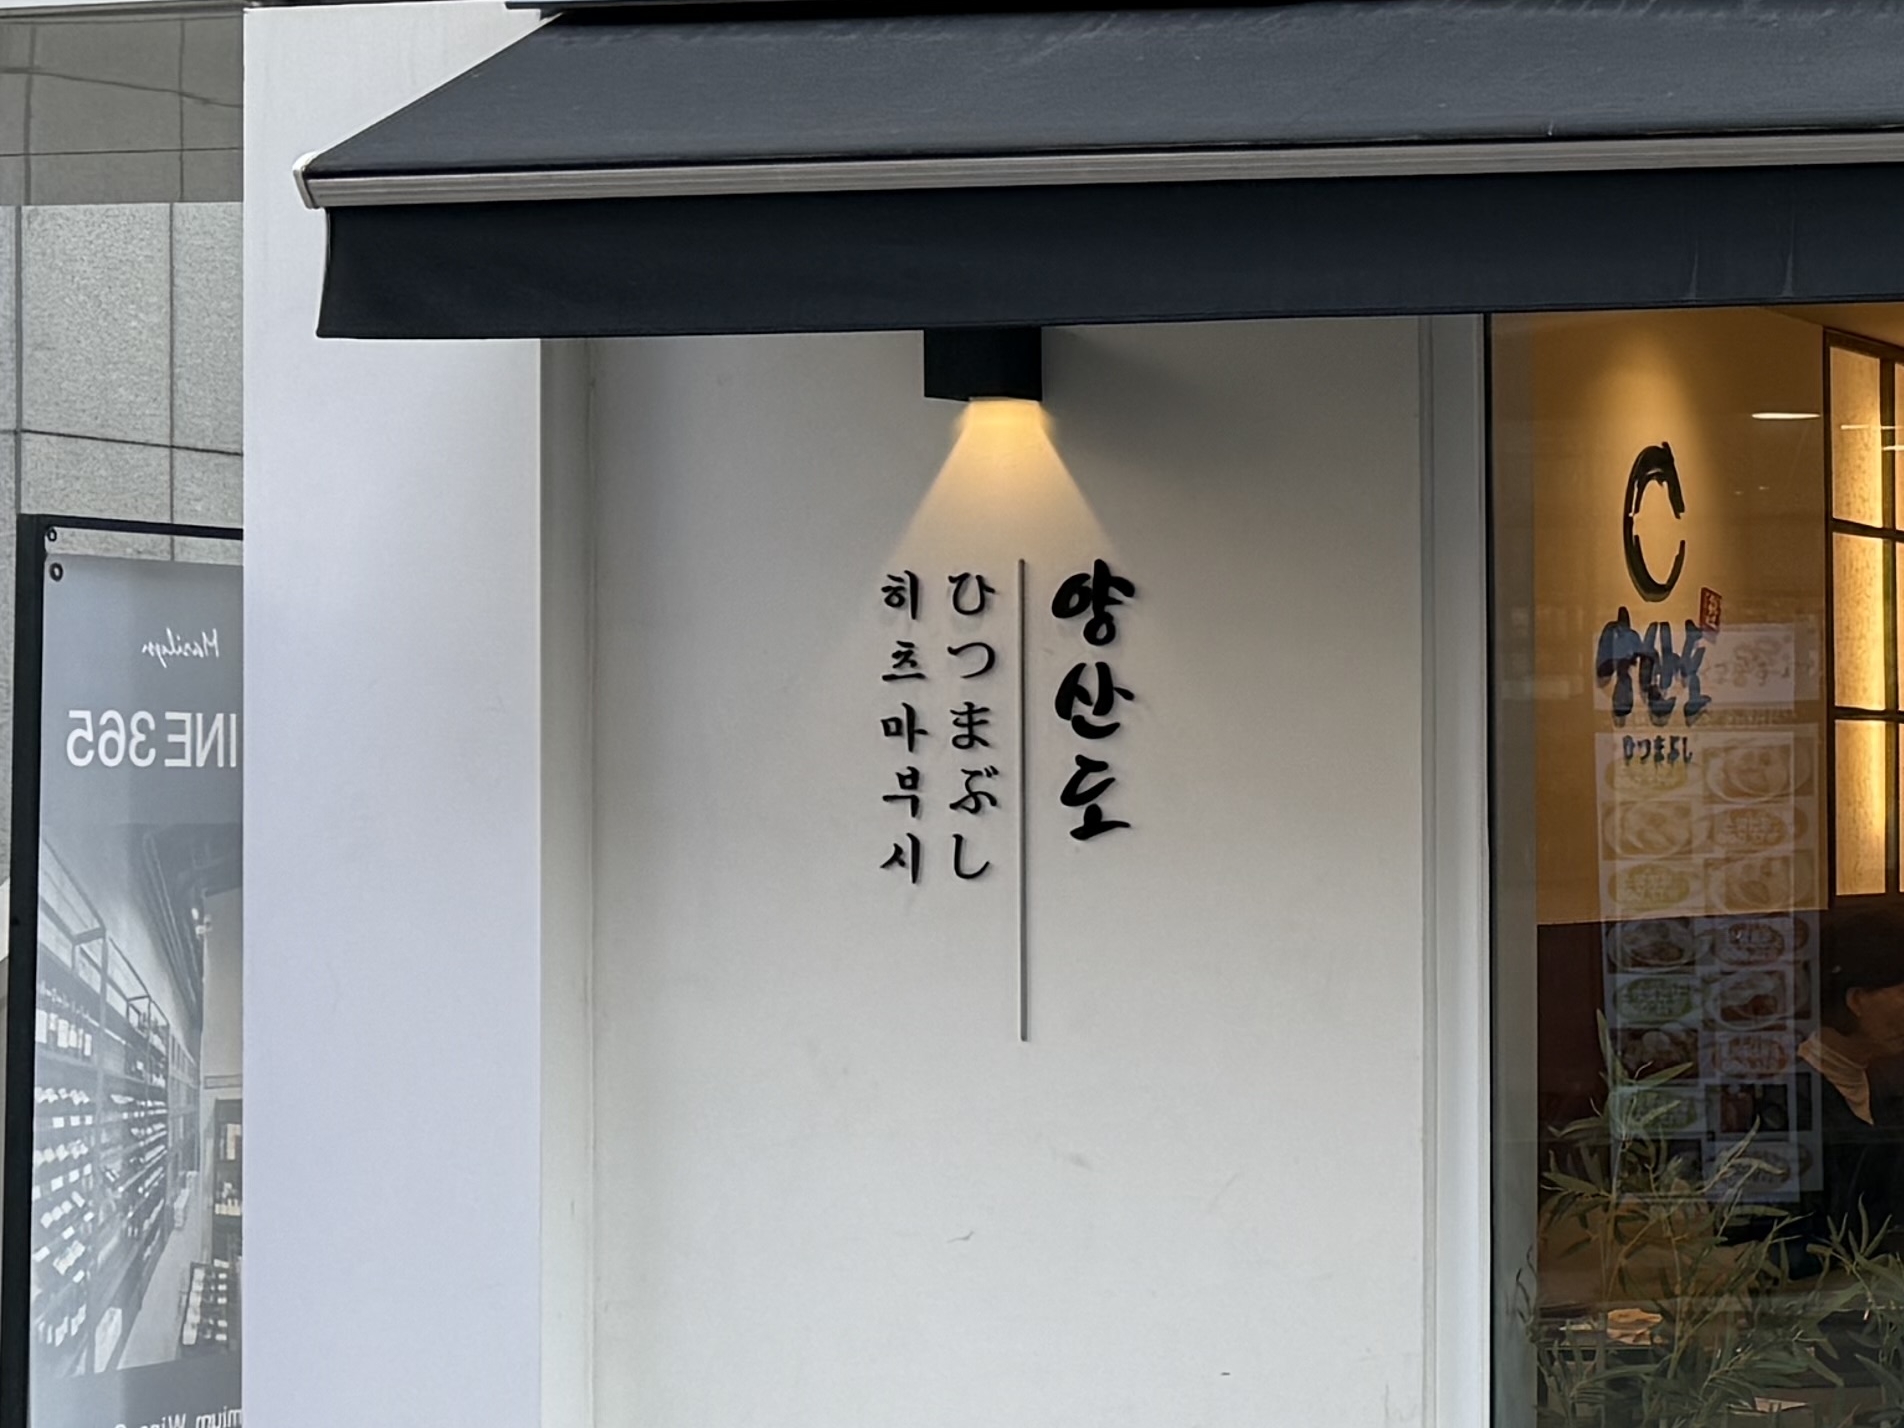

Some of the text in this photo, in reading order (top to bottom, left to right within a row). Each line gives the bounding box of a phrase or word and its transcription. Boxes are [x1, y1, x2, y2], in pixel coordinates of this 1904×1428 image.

[880, 569, 928, 885] 히츠마부시
[947, 571, 1000, 880] ひつまぶし
[1051, 558, 1136, 841] 양산도
